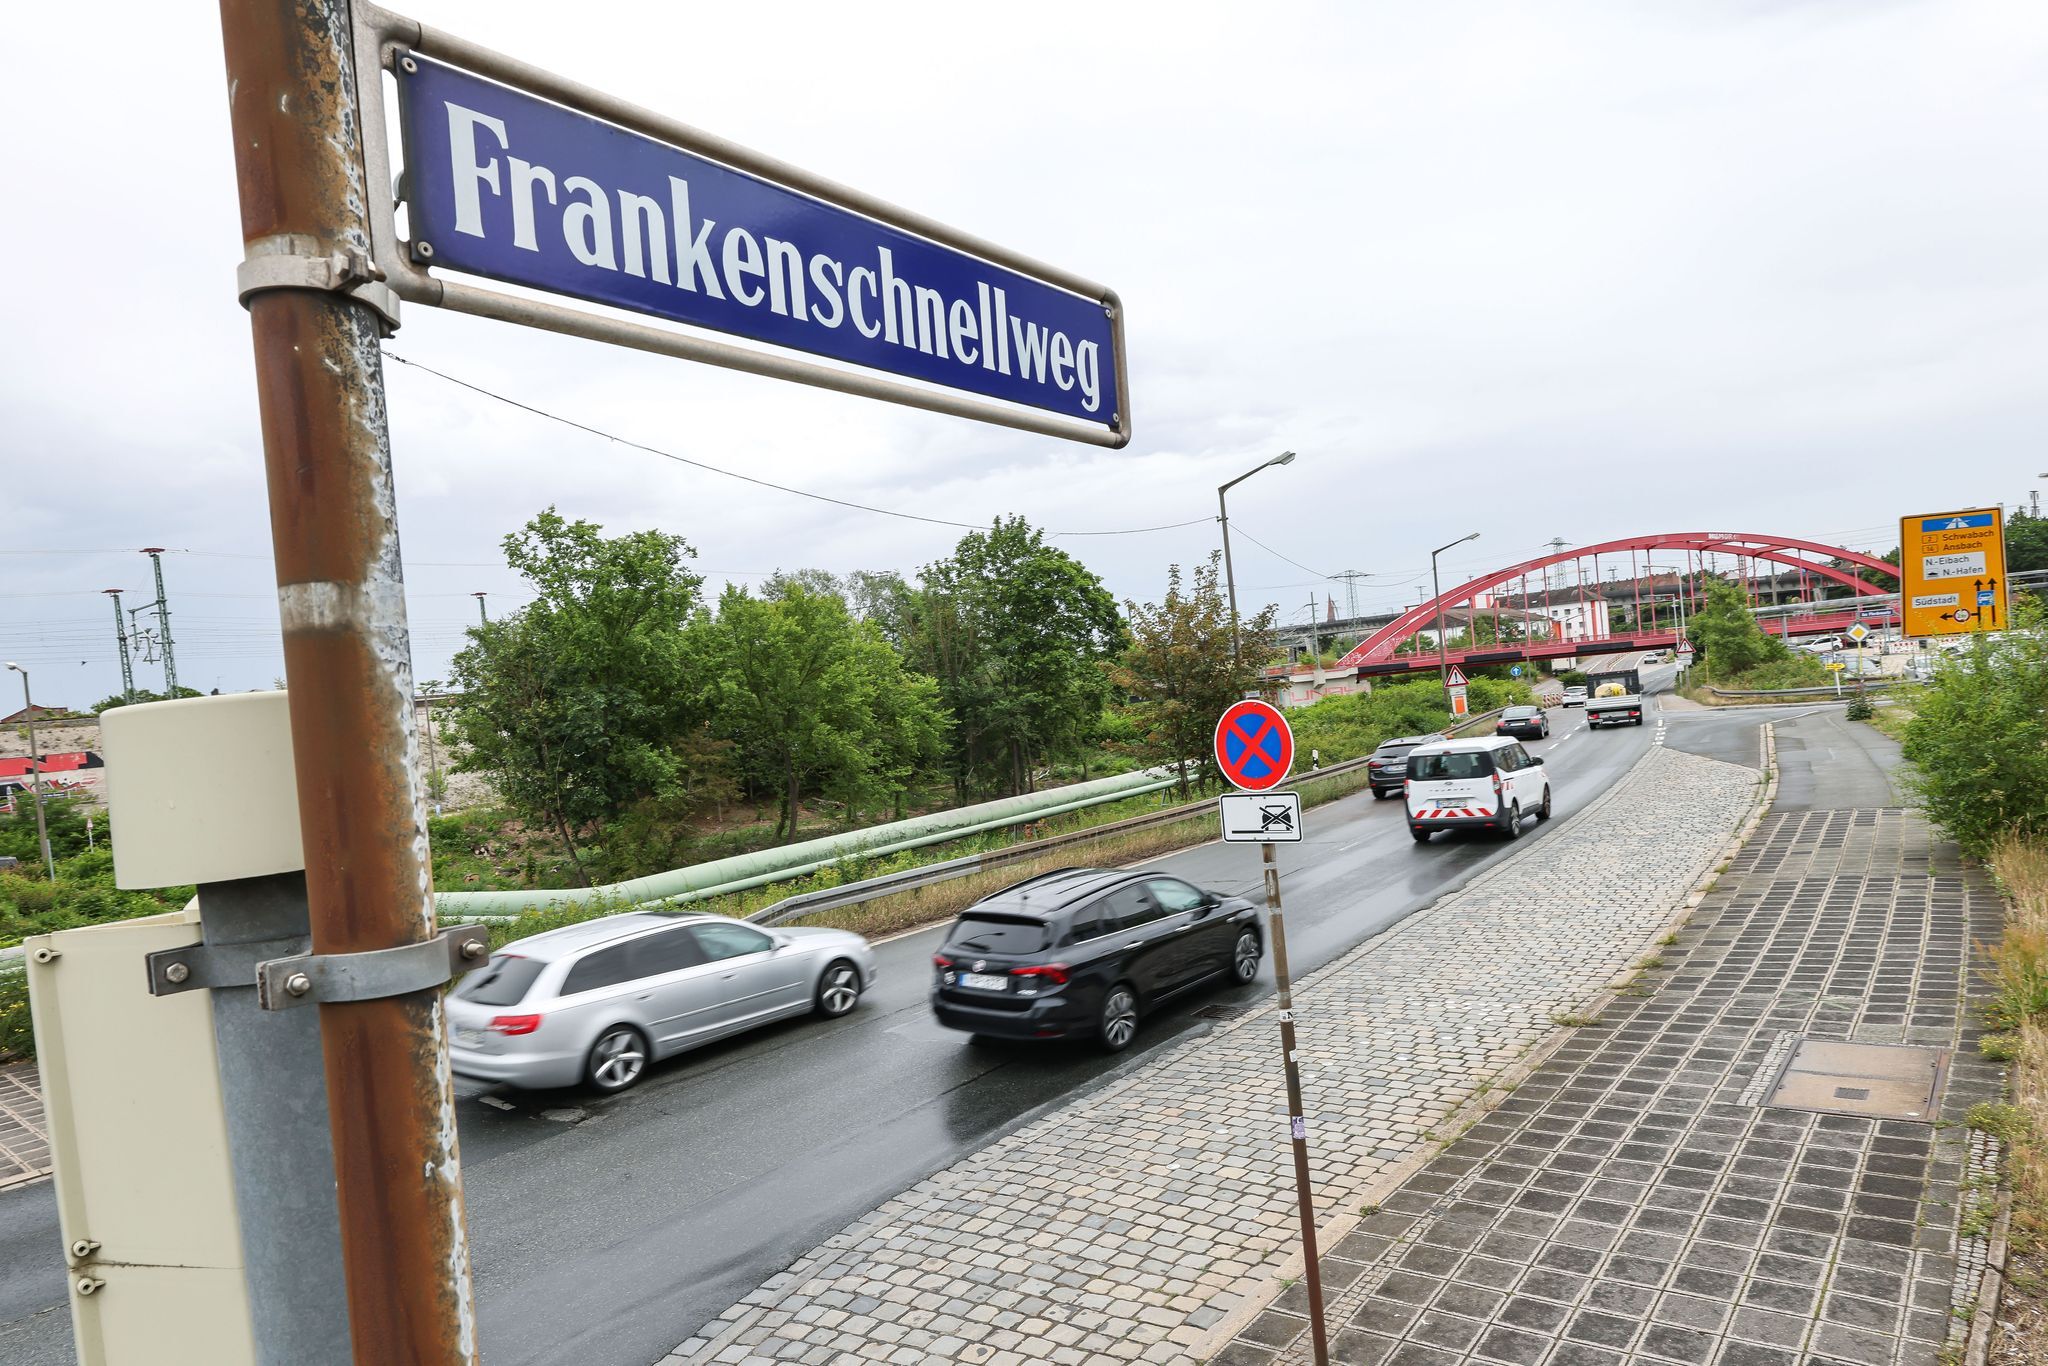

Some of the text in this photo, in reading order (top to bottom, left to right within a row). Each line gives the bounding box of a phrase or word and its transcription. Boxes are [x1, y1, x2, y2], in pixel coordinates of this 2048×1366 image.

[444, 100, 1100, 412] Frankenschnellweg
[1942, 530, 1994, 541] Schwabach
[1943, 541, 1983, 551] Ansbach
[1926, 556, 1970, 566] N.-Eibach
[1943, 566, 1983, 576] N.-Hafen
[1915, 596, 1956, 606] Südstadt
